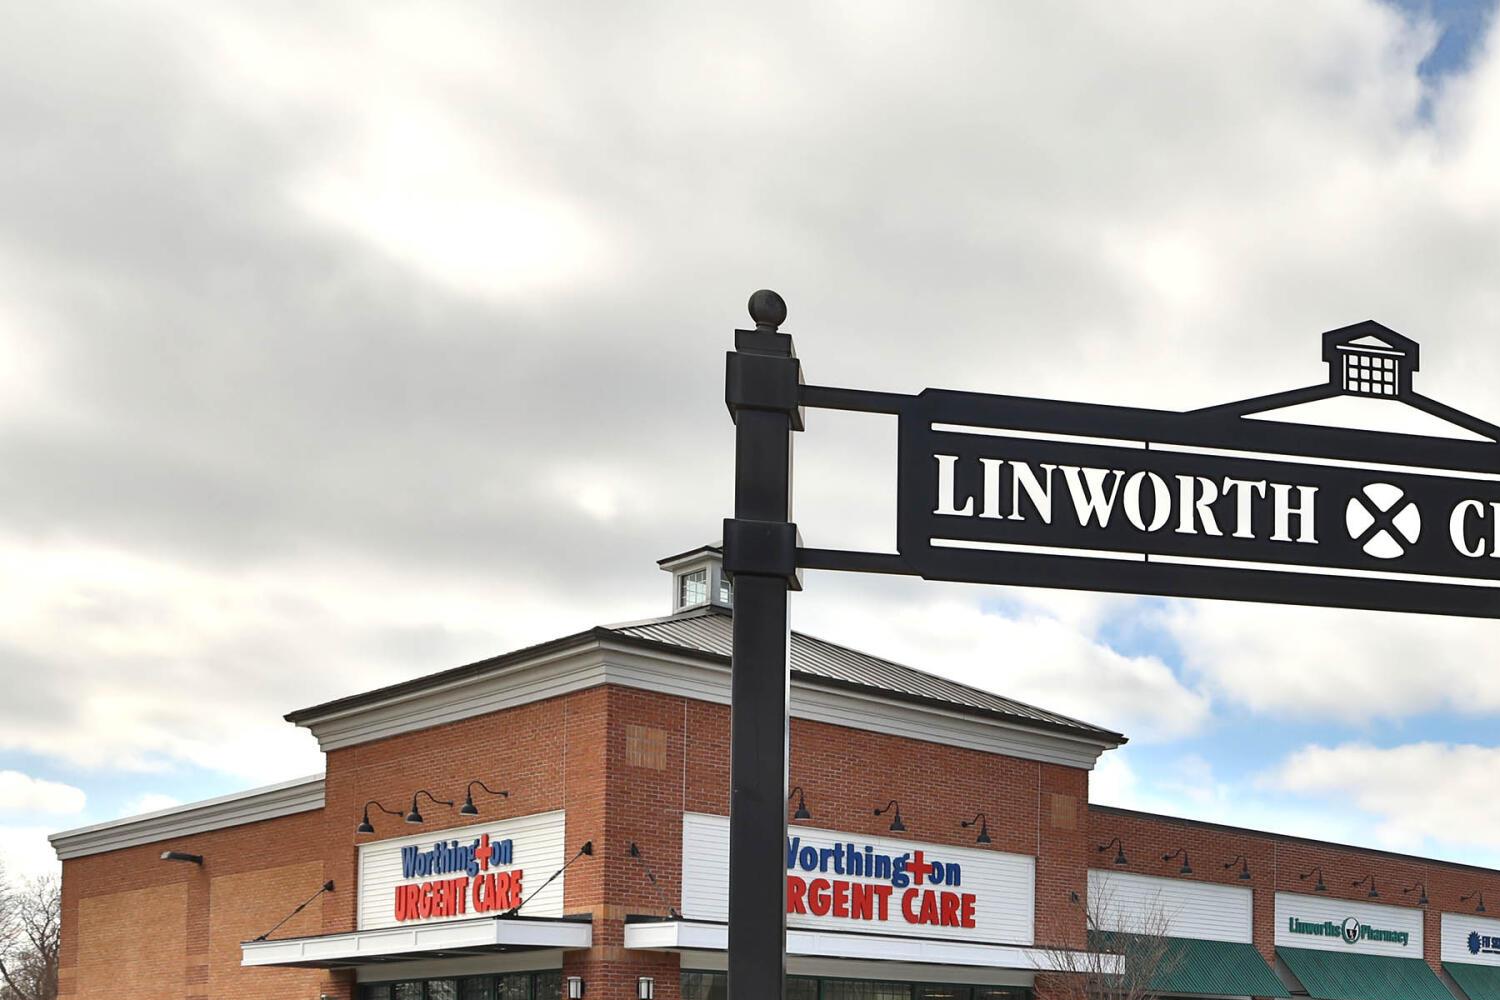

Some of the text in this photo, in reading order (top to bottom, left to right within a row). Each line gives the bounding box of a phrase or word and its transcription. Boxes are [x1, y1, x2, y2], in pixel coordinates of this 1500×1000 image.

[933, 454, 1319, 544] LINWORTH
[401, 833, 513, 878] Worthington
[395, 869, 523, 922] URGENT CARE
[788, 875, 977, 929] RGENT CARE
[1360, 924, 1409, 946] Pharmacy
